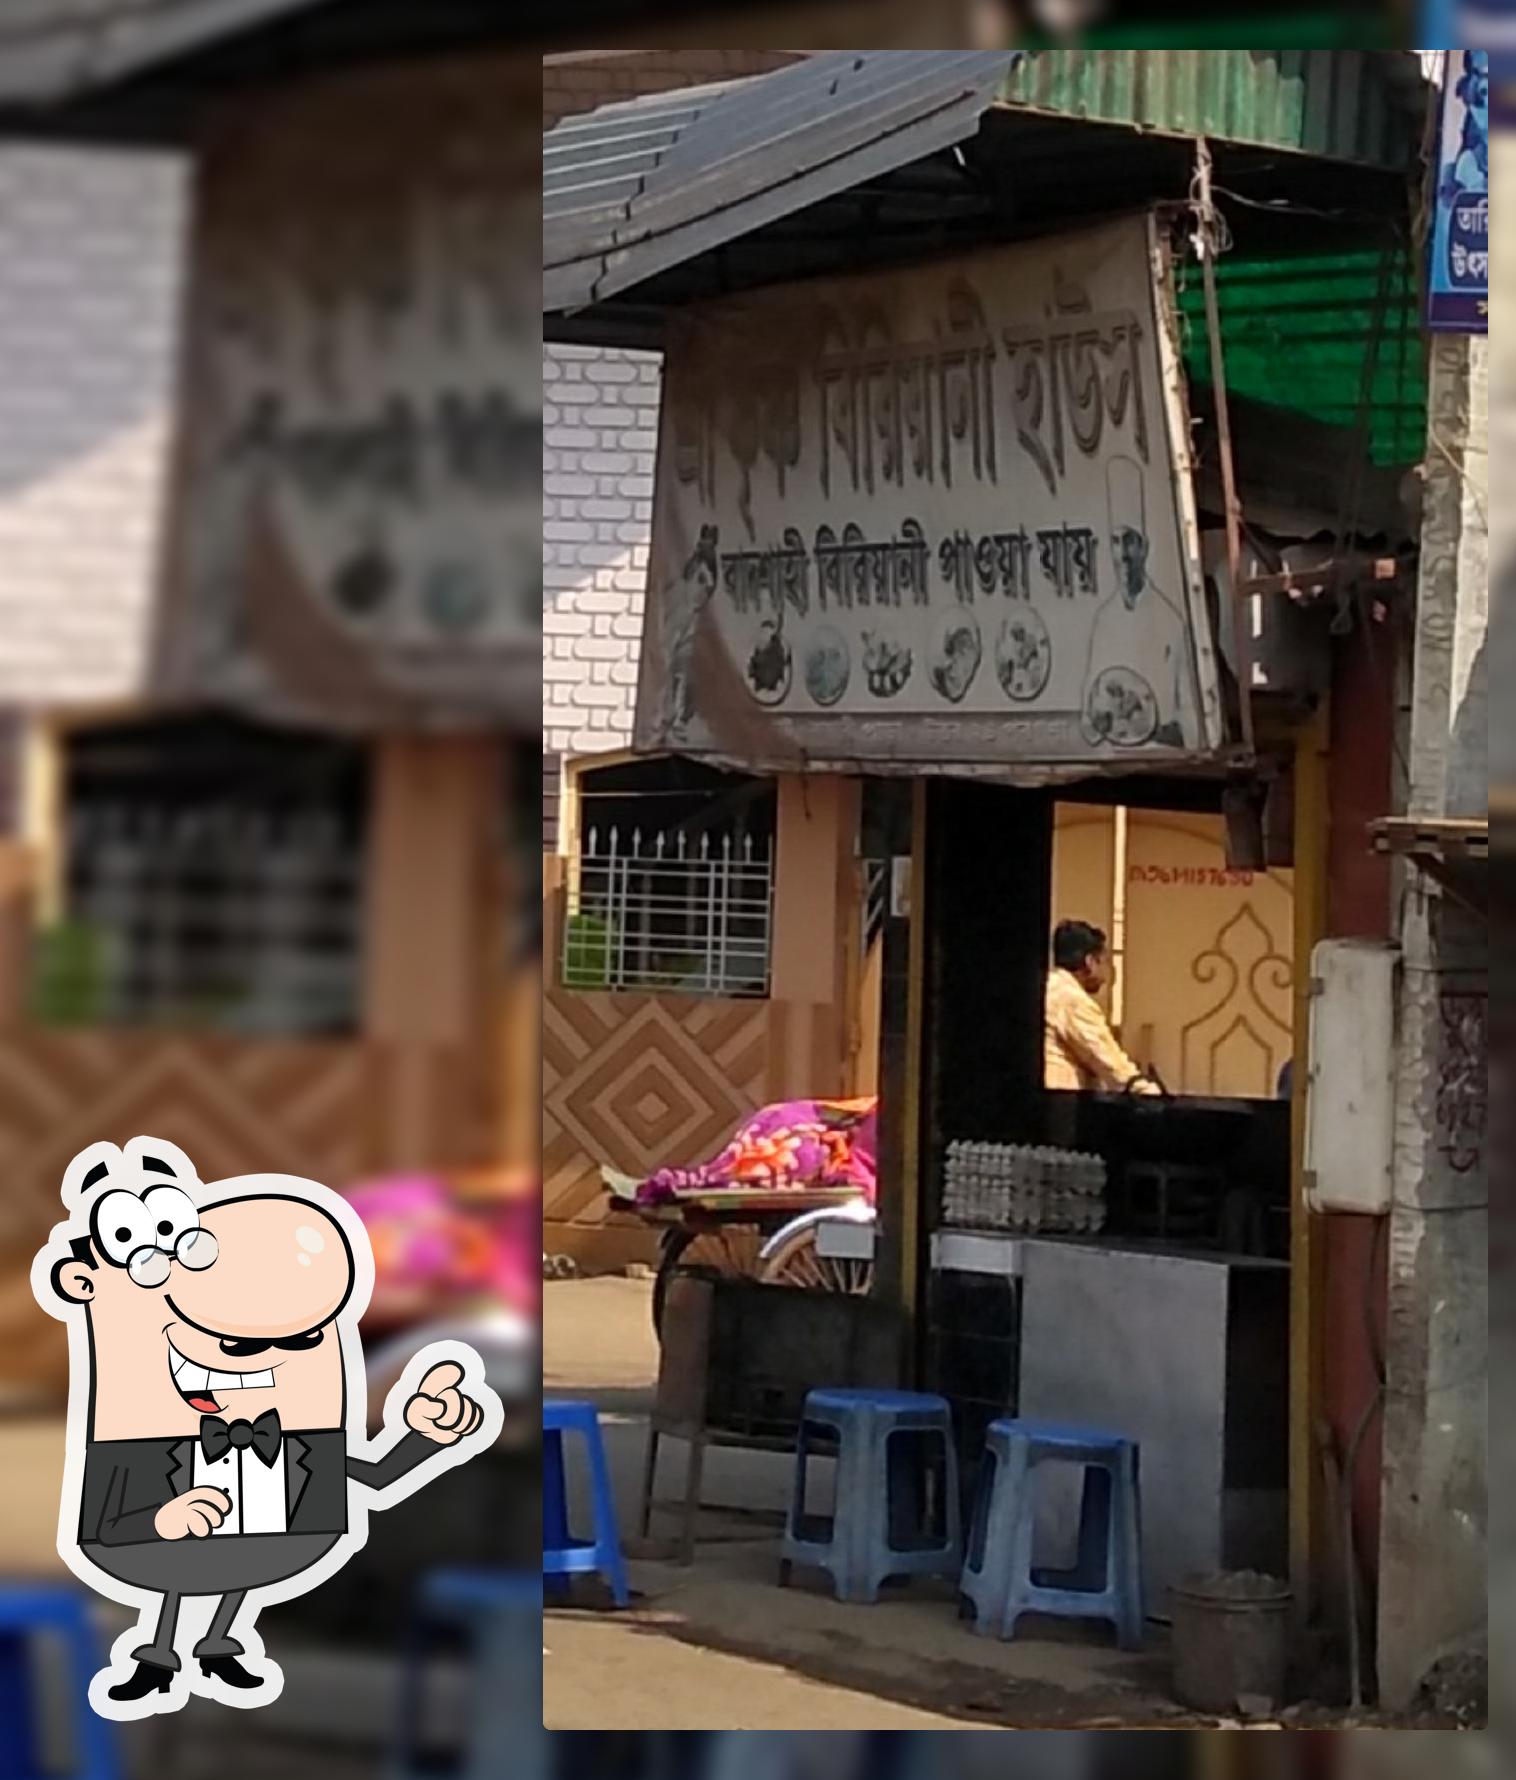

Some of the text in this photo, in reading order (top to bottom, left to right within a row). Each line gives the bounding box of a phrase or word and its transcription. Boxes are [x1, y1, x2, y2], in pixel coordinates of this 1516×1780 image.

[813, 516, 931, 611] বিরিয়ানী
[938, 523, 1032, 605] পাওয়া
[1035, 521, 1098, 598] যায়
